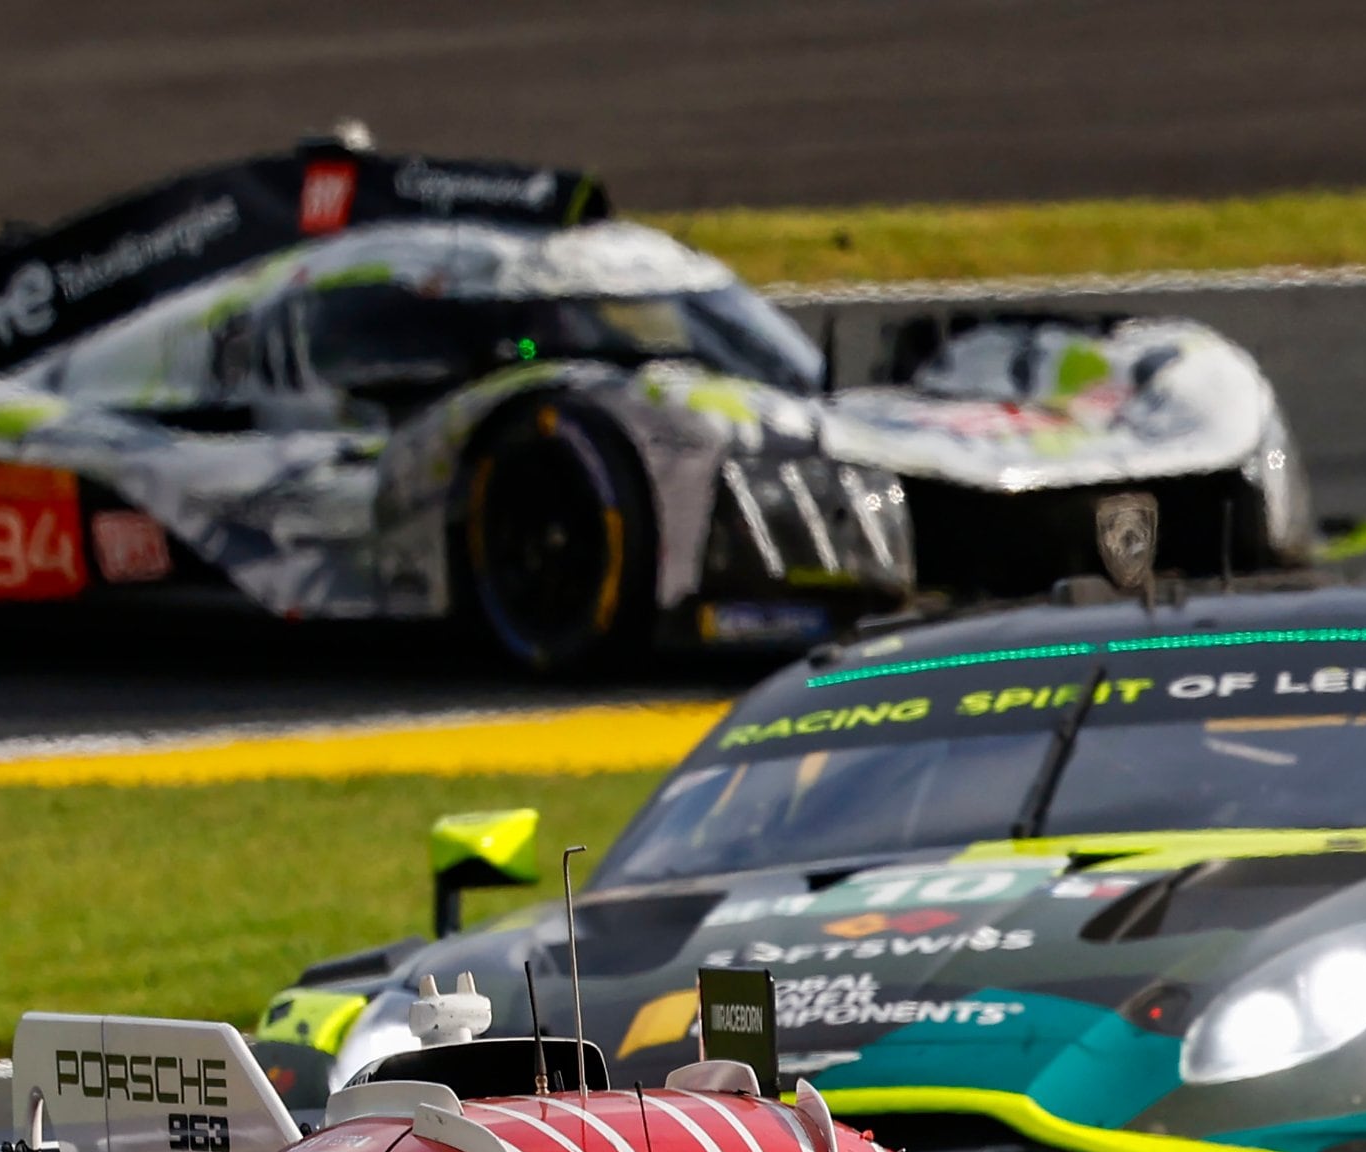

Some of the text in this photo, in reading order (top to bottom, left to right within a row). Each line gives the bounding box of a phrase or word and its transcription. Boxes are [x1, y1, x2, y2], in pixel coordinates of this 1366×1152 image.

[718, 698, 931, 750] RACING
[956, 678, 1154, 717] SPIRIT
[1167, 671, 1257, 700] OF
[718, 1003, 763, 1035] RACEBORN
[56, 1050, 228, 1107] PORSCHE
